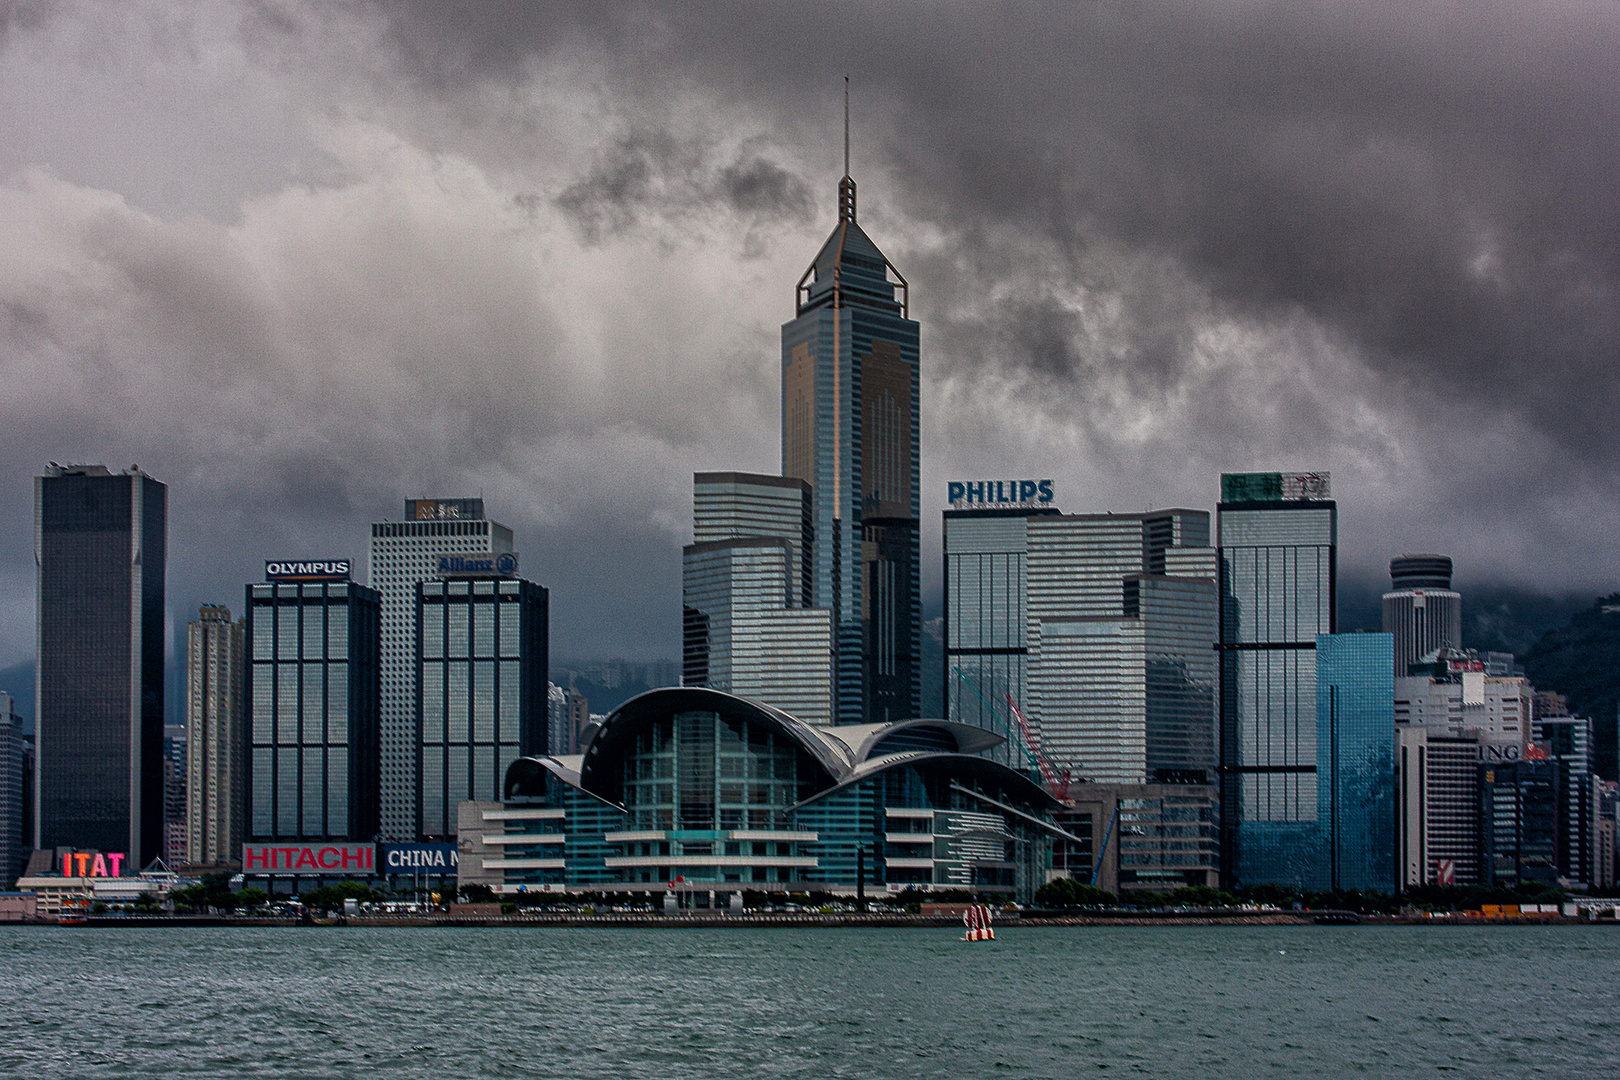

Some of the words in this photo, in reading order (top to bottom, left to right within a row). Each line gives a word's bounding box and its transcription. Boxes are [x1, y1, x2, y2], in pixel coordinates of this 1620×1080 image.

[948, 480, 1054, 503] PHILIPS
[267, 562, 349, 574] OLYMPUS
[439, 556, 493, 572] Allianz
[1478, 745, 1519, 760] ING
[63, 853, 125, 877] ITAT
[246, 847, 372, 869] HITACHI
[387, 850, 446, 867] CHINA
